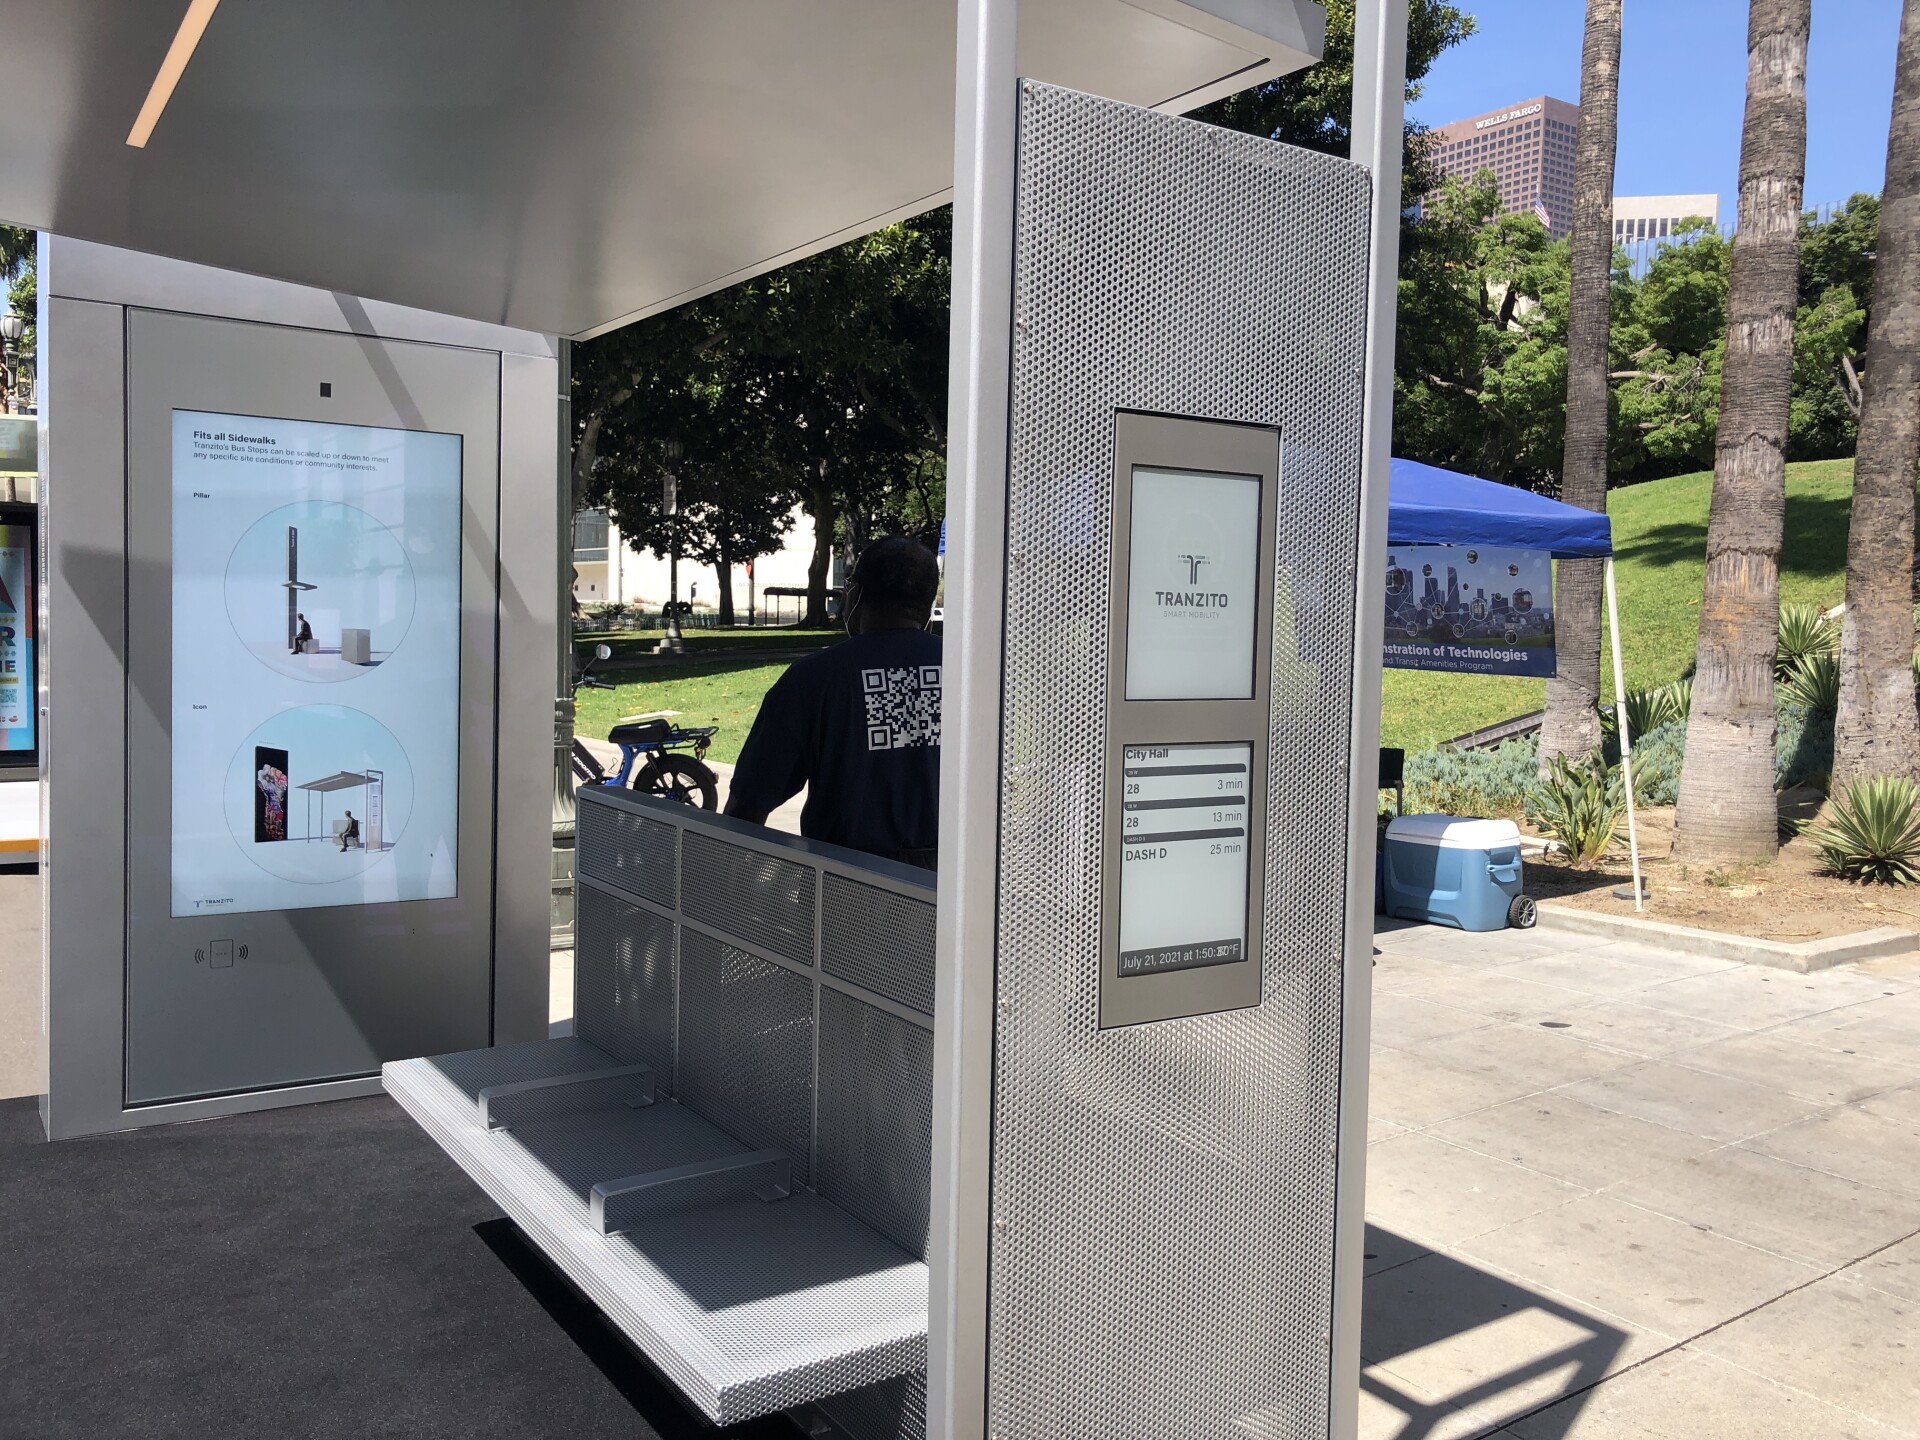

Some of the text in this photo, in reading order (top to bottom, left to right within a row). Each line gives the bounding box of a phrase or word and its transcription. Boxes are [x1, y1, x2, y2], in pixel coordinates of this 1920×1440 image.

[1475, 104, 1541, 129] WELLS FARGO
[193, 430, 276, 445] Fits all Sidewalks
[193, 441, 229, 451] Tranzito's
[231, 444, 246, 452] Bus
[247, 445, 269, 455] Stops
[285, 448, 295, 456] be
[297, 450, 320, 458] scaled
[342, 453, 361, 461] down
[193, 452, 208, 460] any
[209, 453, 239, 461] specific
[255, 456, 294, 465] conditions
[304, 460, 345, 471] community
[346, 462, 378, 471] interests.
[1155, 591, 1228, 608] TRANZITO
[1163, 610, 1221, 619] SMART MOBILITY
[1432, 645, 1445, 657] of
[1447, 646, 1528, 662] Technologies
[1395, 656, 1419, 666] Transit
[1420, 658, 1458, 669] Amenities
[1459, 661, 1494, 671] Program
[1125, 748, 1169, 762] City Hall
[1126, 783, 1140, 794] 28
[1217, 778, 1243, 790] 3 min
[1126, 817, 1139, 828] 28
[1213, 810, 1242, 823] 13 min
[1125, 847, 1168, 862] DASH D
[1210, 842, 1241, 855] 25 min
[1122, 956, 1142, 970] July
[1144, 954, 1157, 967] 21,
[1159, 951, 1181, 964] 2021
[1183, 949, 1193, 961] at
